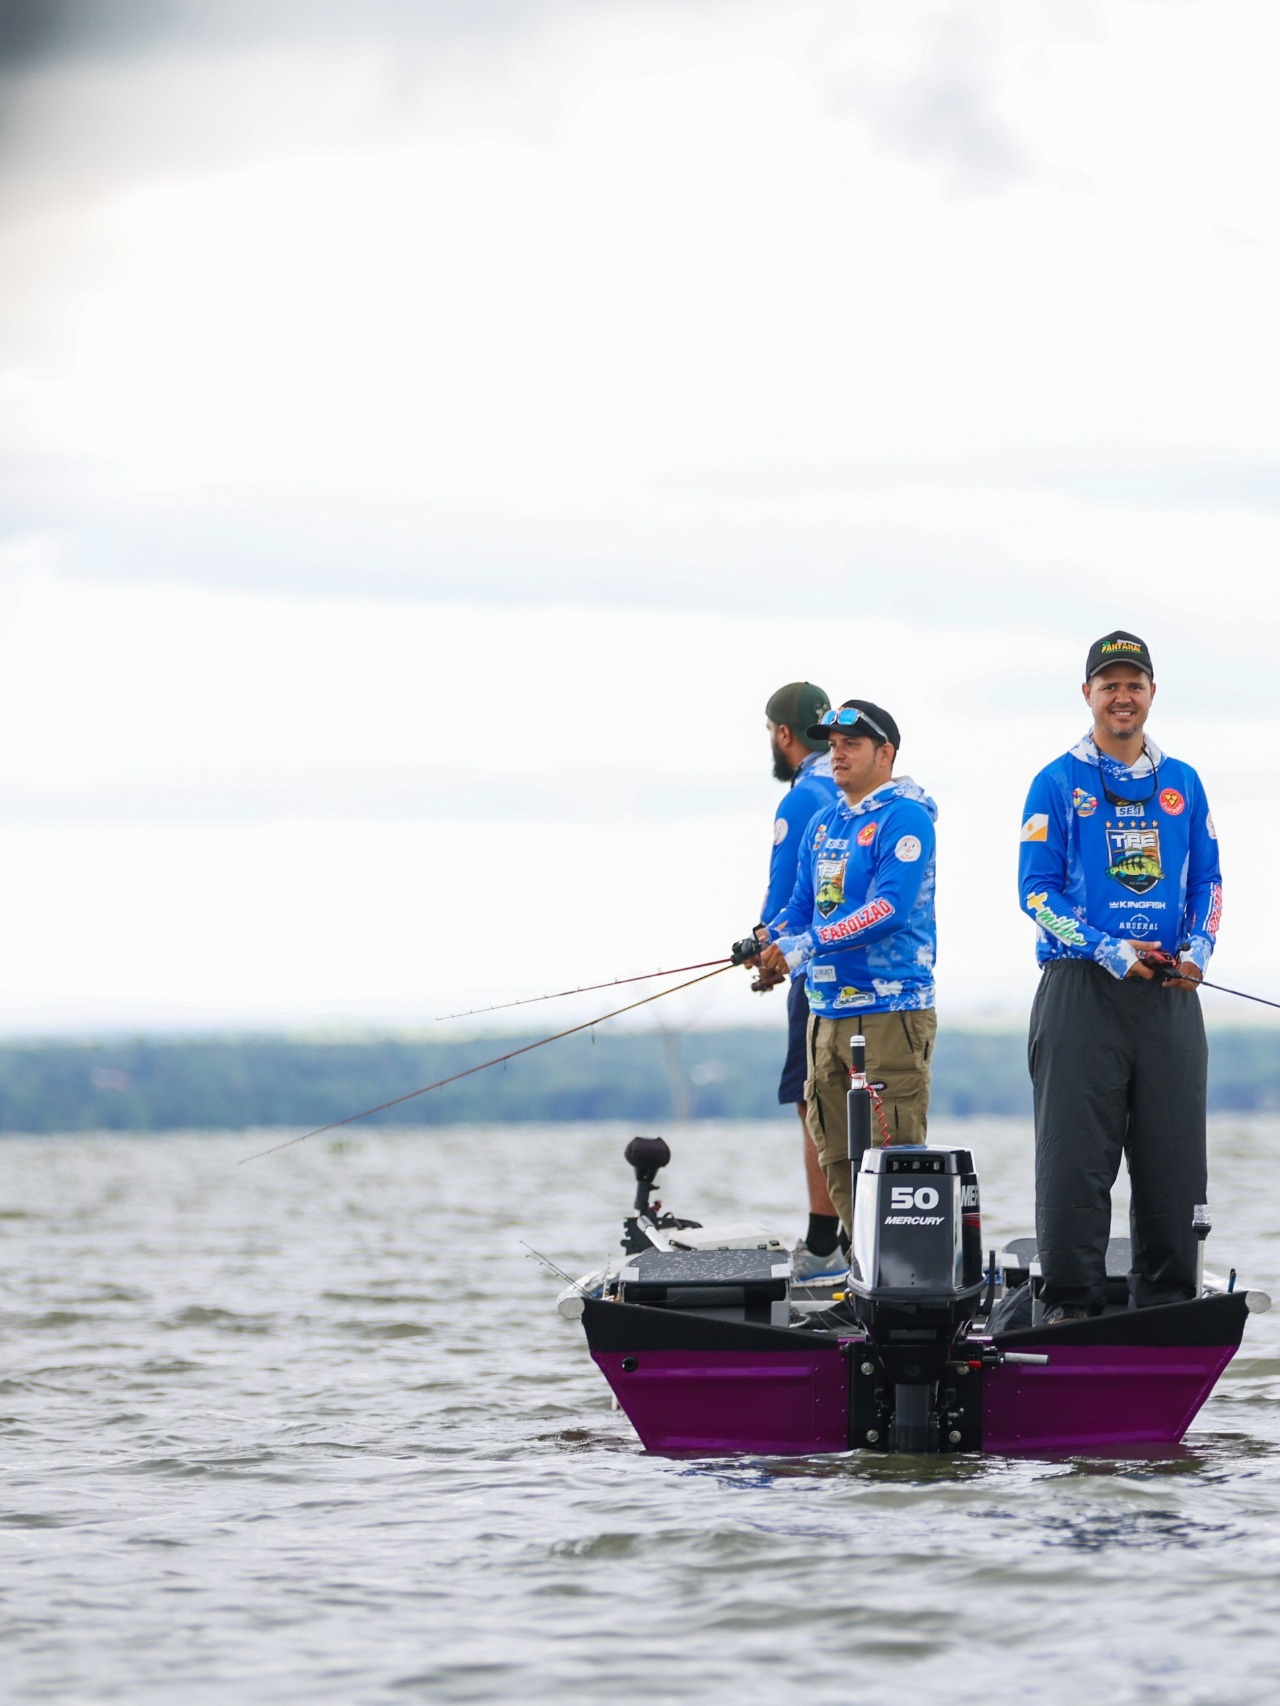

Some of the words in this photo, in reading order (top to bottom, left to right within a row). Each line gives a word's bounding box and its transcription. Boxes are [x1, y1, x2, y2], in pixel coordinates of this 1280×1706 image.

[1120, 901, 1166, 909] KINGFISH
[891, 1187, 940, 1210] 50
[884, 1216, 945, 1226] MERCURY
